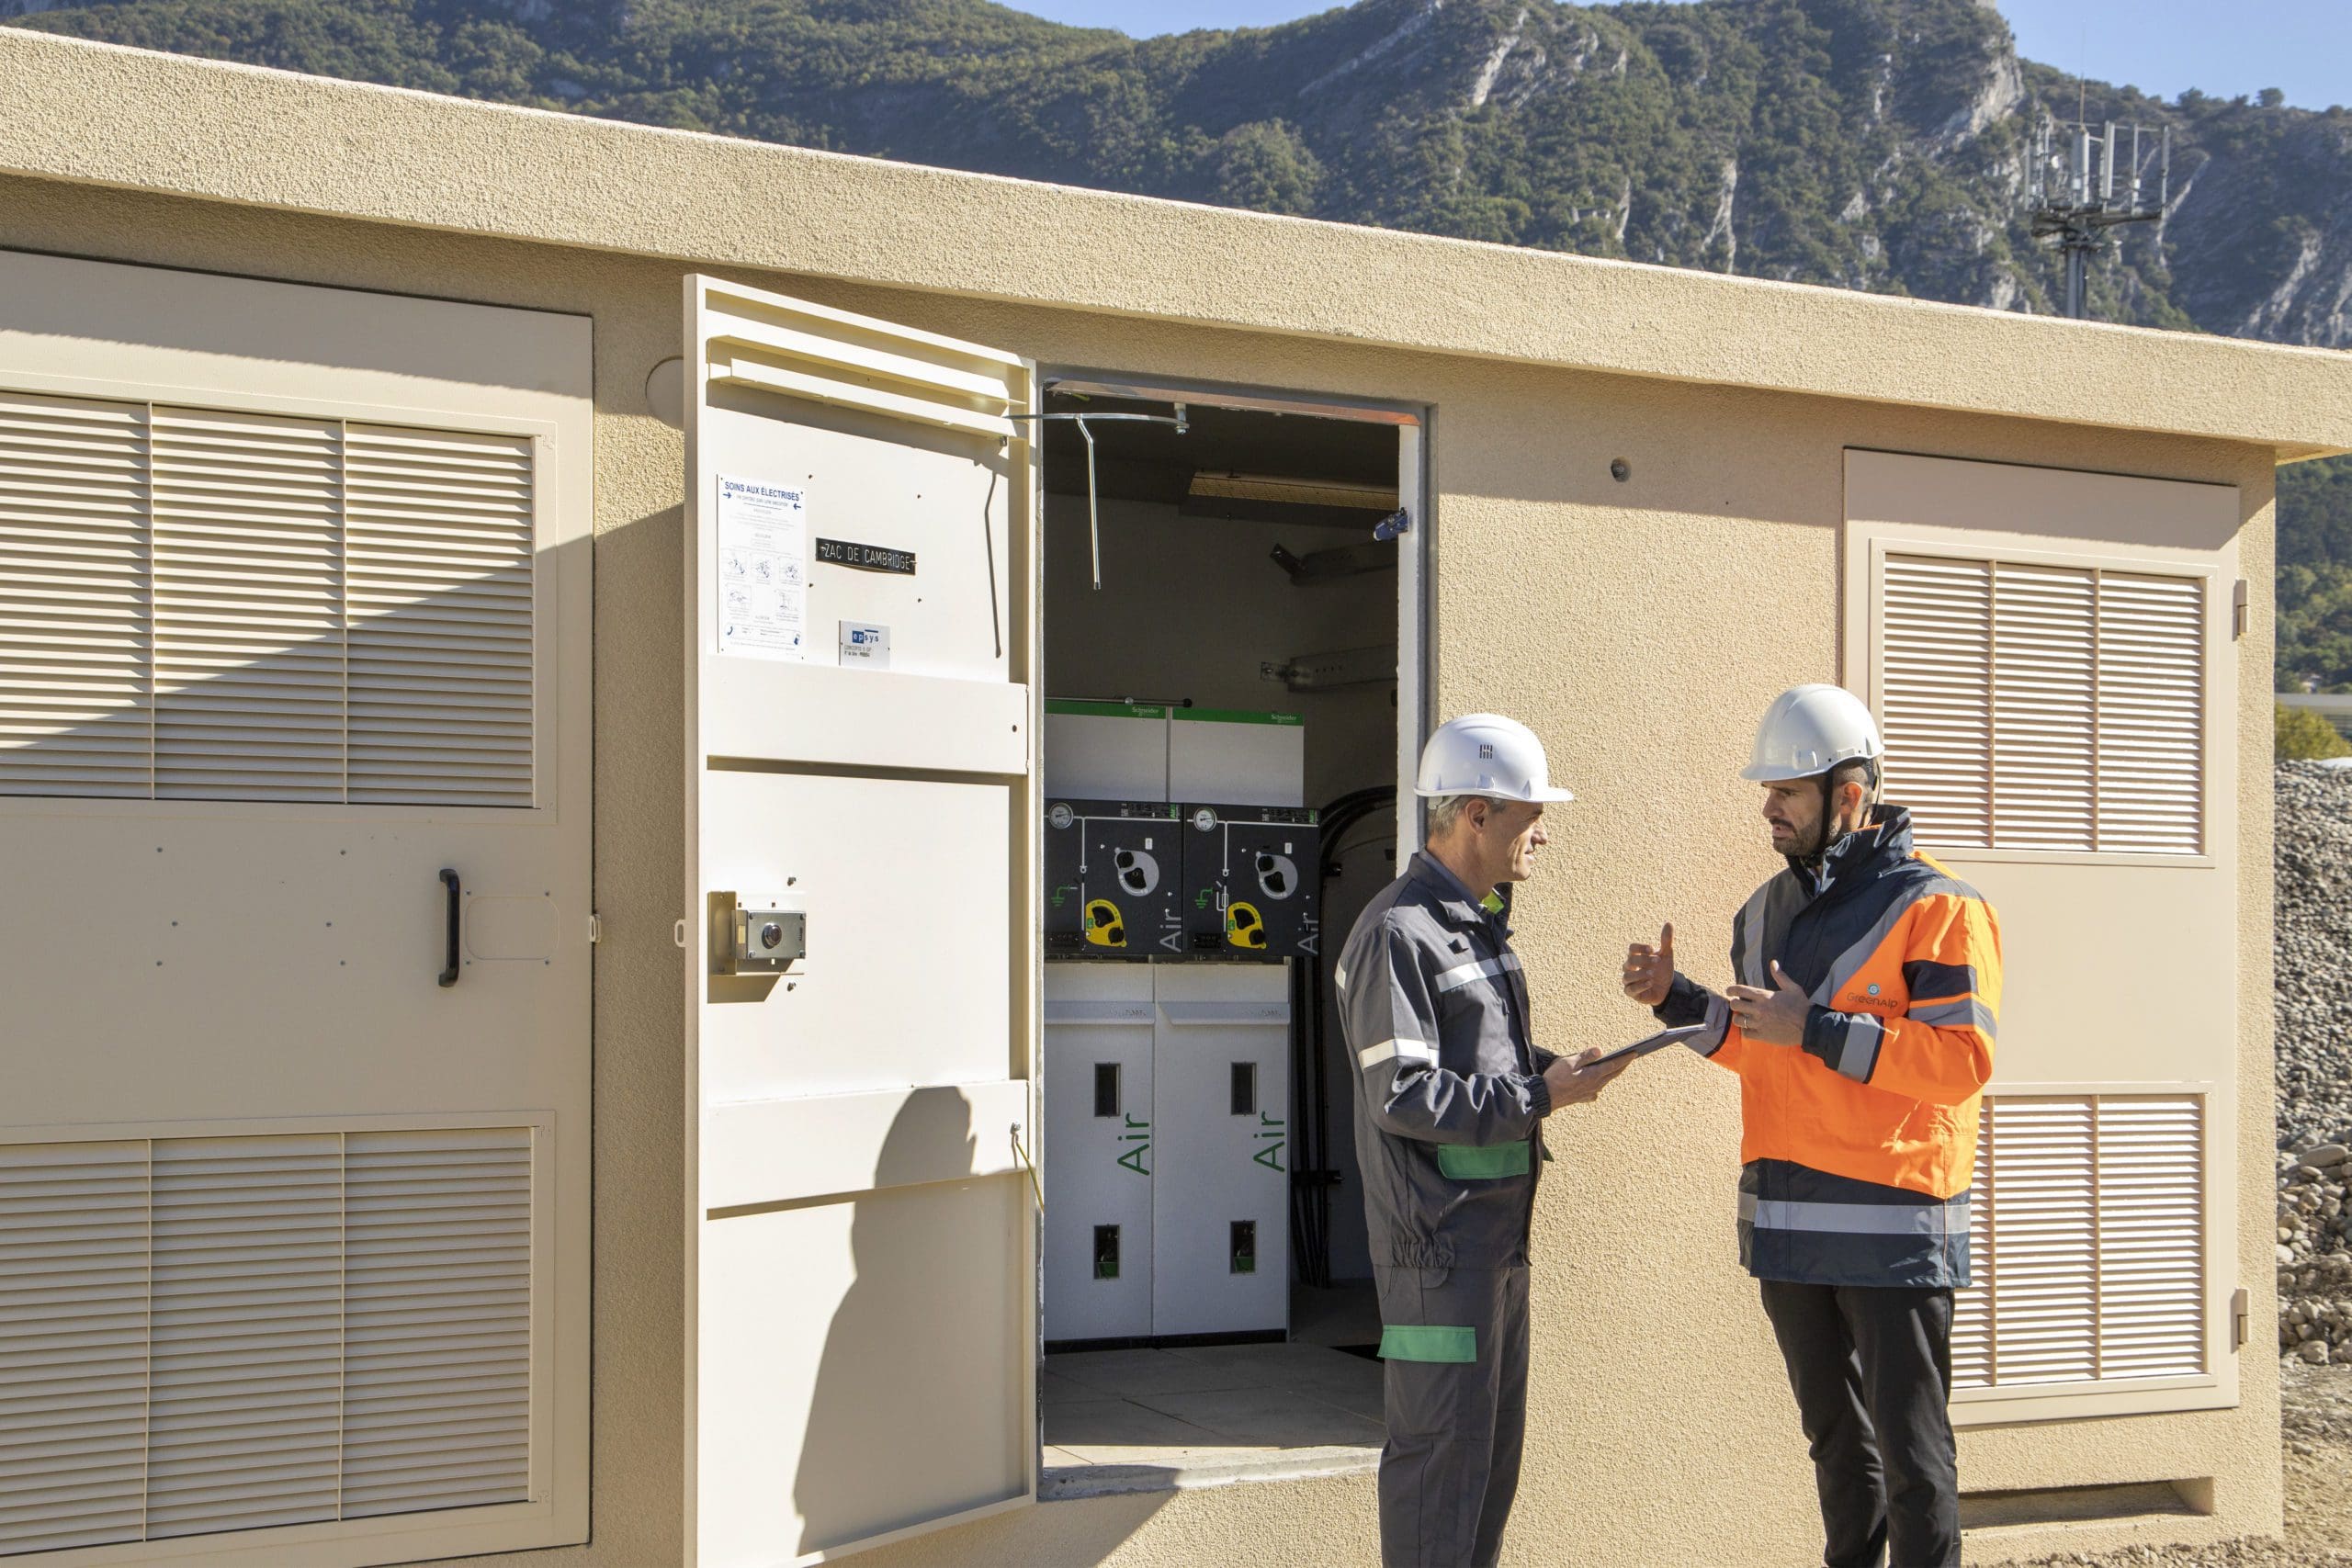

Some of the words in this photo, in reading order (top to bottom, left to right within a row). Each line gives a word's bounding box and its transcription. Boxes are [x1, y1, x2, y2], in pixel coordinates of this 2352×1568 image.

[725, 481, 745, 492] SOINS
[746, 485, 760, 494] AUX
[761, 487, 800, 502] ÉLECTRISÉS
[824, 543, 842, 559] ZAC
[847, 546, 860, 562] DE
[865, 549, 910, 570] CAMBRIDGE
[853, 631, 879, 644] epsys
[1159, 908, 1182, 953] Air
[1117, 1111, 1150, 1176] Air
[1252, 1111, 1285, 1173] Air
